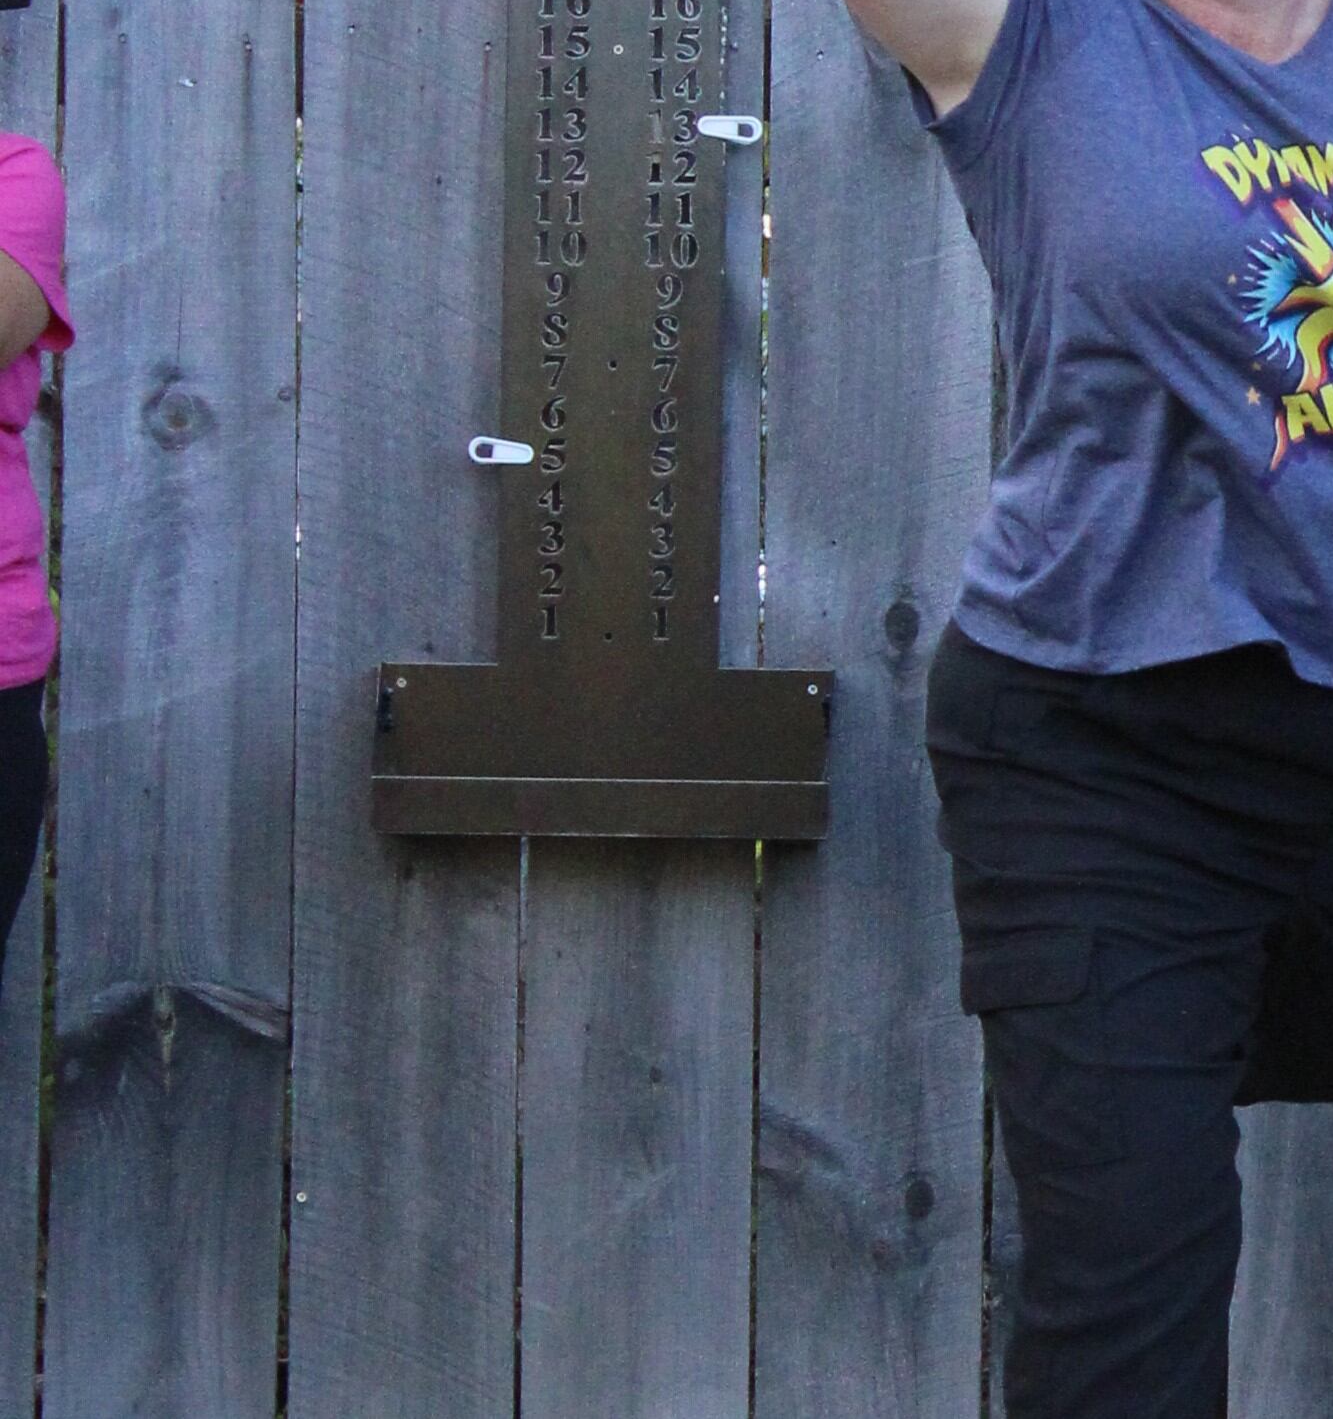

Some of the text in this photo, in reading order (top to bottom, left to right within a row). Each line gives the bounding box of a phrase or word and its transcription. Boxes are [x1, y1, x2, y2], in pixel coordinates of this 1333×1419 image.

[538, 25, 590, 59] 15
[649, 26, 702, 62] 15
[536, 68, 588, 101] 14
[649, 69, 701, 103] 14
[536, 108, 588, 142] 13
[648, 109, 698, 145] 13
[536, 149, 588, 183] 12
[648, 150, 697, 185] 12
[535, 190, 584, 225] 11
[645, 190, 695, 228] 11
[535, 230, 587, 266] 10
[645, 230, 699, 269] 10
[545, 272, 571, 307] 9
[655, 273, 683, 309] 9
[542, 312, 568, 348] 8
[652, 314, 680, 351] 8
[542, 354, 569, 389] 7
[653, 357, 680, 392] 7
[541, 395, 567, 431] 6
[651, 397, 679, 434] 6
[540, 437, 566, 472] 5
[651, 439, 678, 476] 5
[538, 480, 564, 515] 4
[649, 482, 676, 517] 4
[540, 521, 565, 556] 3
[651, 522, 676, 559] 3
[540, 562, 564, 597] 2
[650, 564, 675, 600] 2
[541, 604, 560, 639] 1
[652, 605, 670, 642] 1
